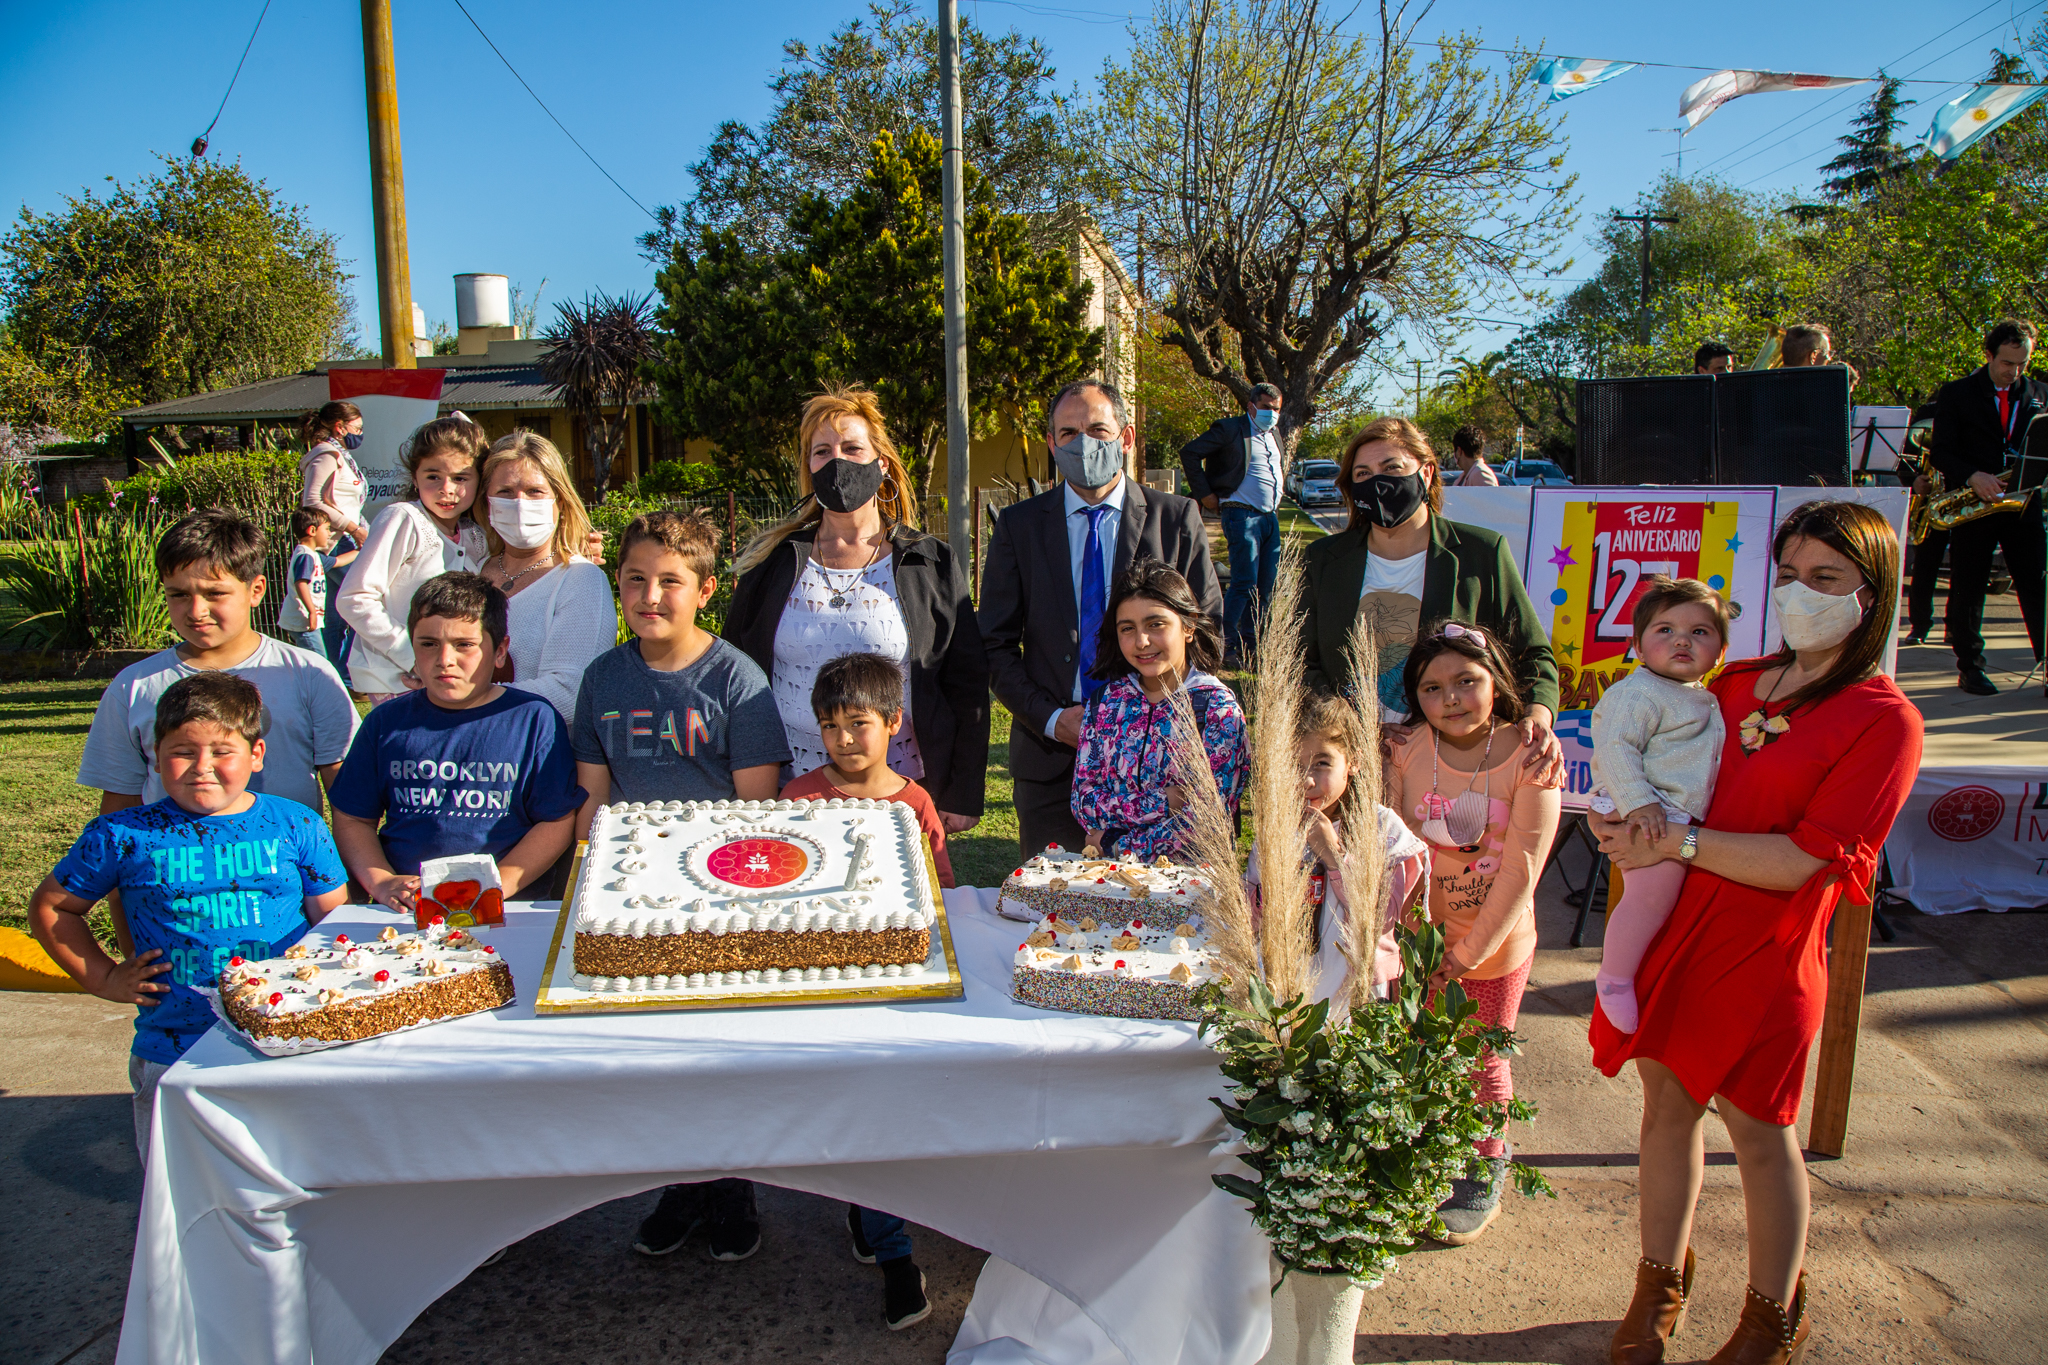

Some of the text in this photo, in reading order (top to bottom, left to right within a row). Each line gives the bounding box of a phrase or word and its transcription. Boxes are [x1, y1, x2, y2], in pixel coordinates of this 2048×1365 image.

[367, 483, 408, 501] ayauca
[1624, 505, 1676, 526] Feliz
[1611, 529, 1701, 552] ANIVERSARIO
[600, 707, 729, 759] TEAM
[390, 760, 519, 782] BROOKLYN
[394, 787, 512, 810] NEW YORK
[151, 838, 280, 884] THE HOLY
[1436, 874, 1459, 889] you
[1445, 875, 1485, 893] should
[1464, 887, 1484, 897] see
[172, 890, 263, 933] SPIRIT
[171, 948, 200, 986] OF
